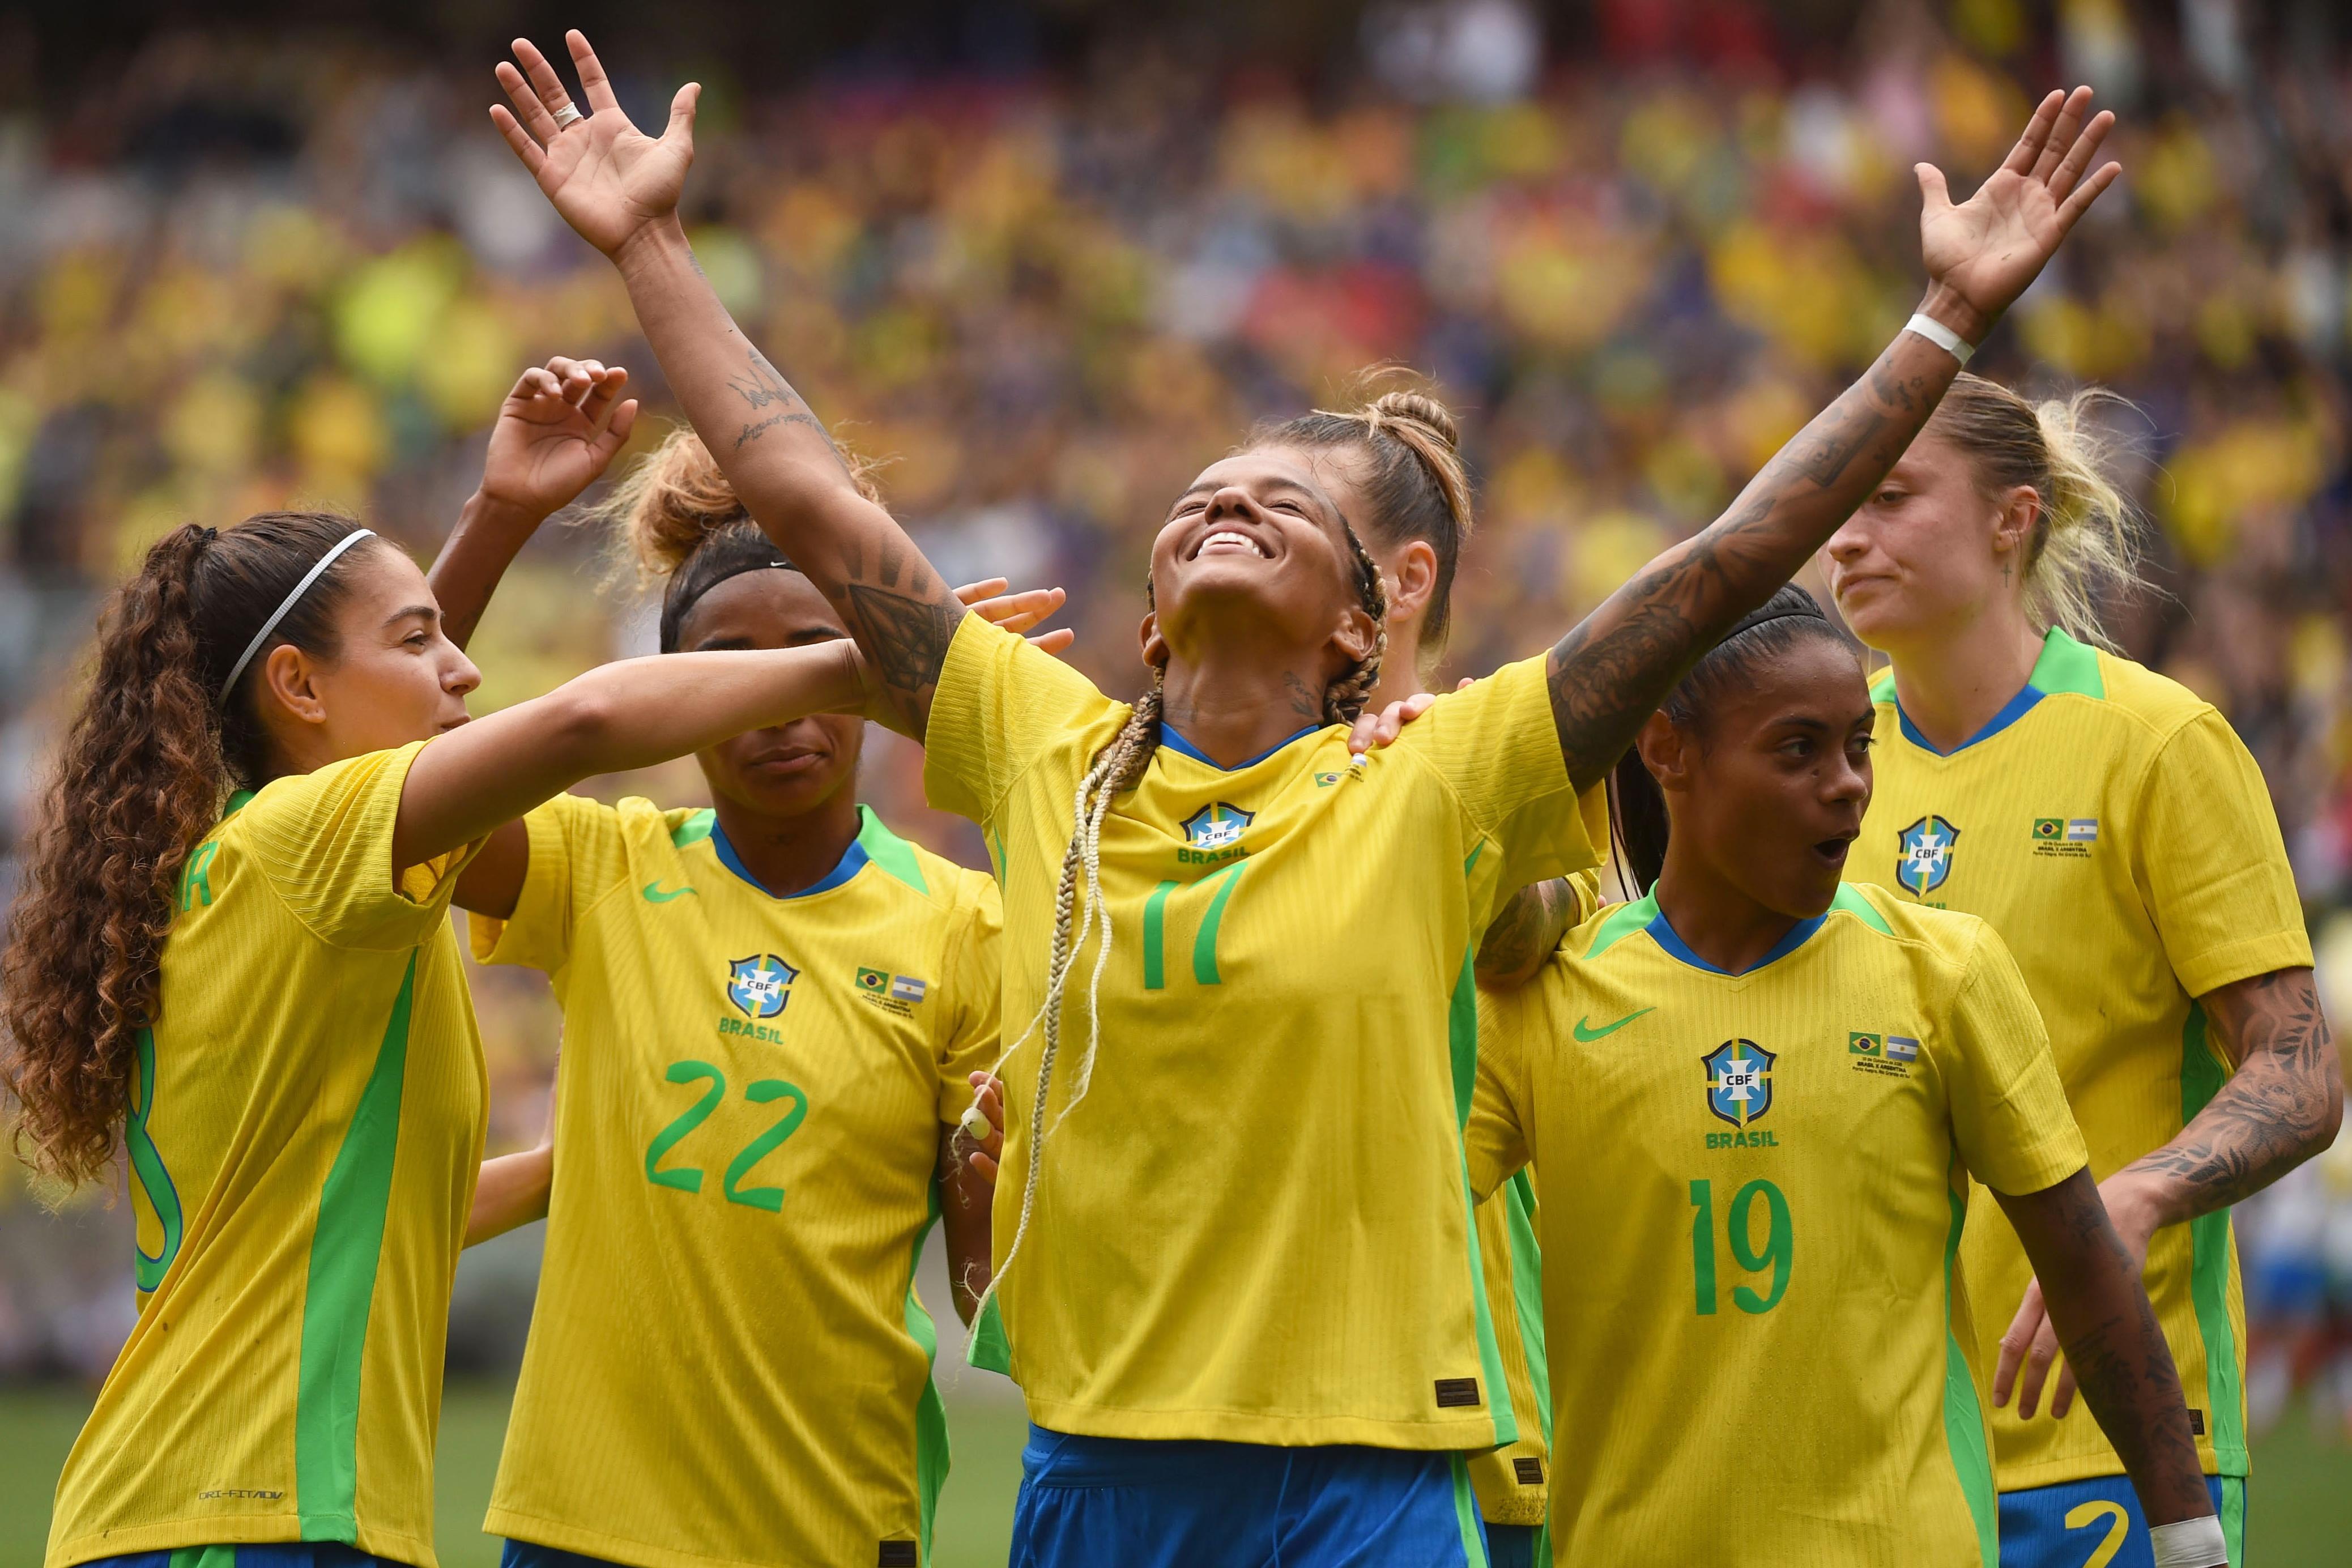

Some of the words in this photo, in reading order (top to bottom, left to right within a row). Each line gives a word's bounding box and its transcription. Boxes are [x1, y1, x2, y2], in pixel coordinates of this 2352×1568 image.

[1205, 831, 1232, 840] CBF
[1178, 846, 1251, 864] BRASIL
[1916, 849, 1938, 858] CBF
[1144, 861, 1249, 989] 17
[747, 981, 773, 991] CBF
[719, 1017, 783, 1045] BRASIL
[1880, 1064, 1906, 1073] ARGENTINA
[1727, 1075, 1752, 1085] CBF
[645, 1060, 808, 1213] 22
[1706, 1131, 1779, 1149] BRASIL
[1689, 1178, 1793, 1315] 19
[2065, 1500, 2129, 1568] 2
